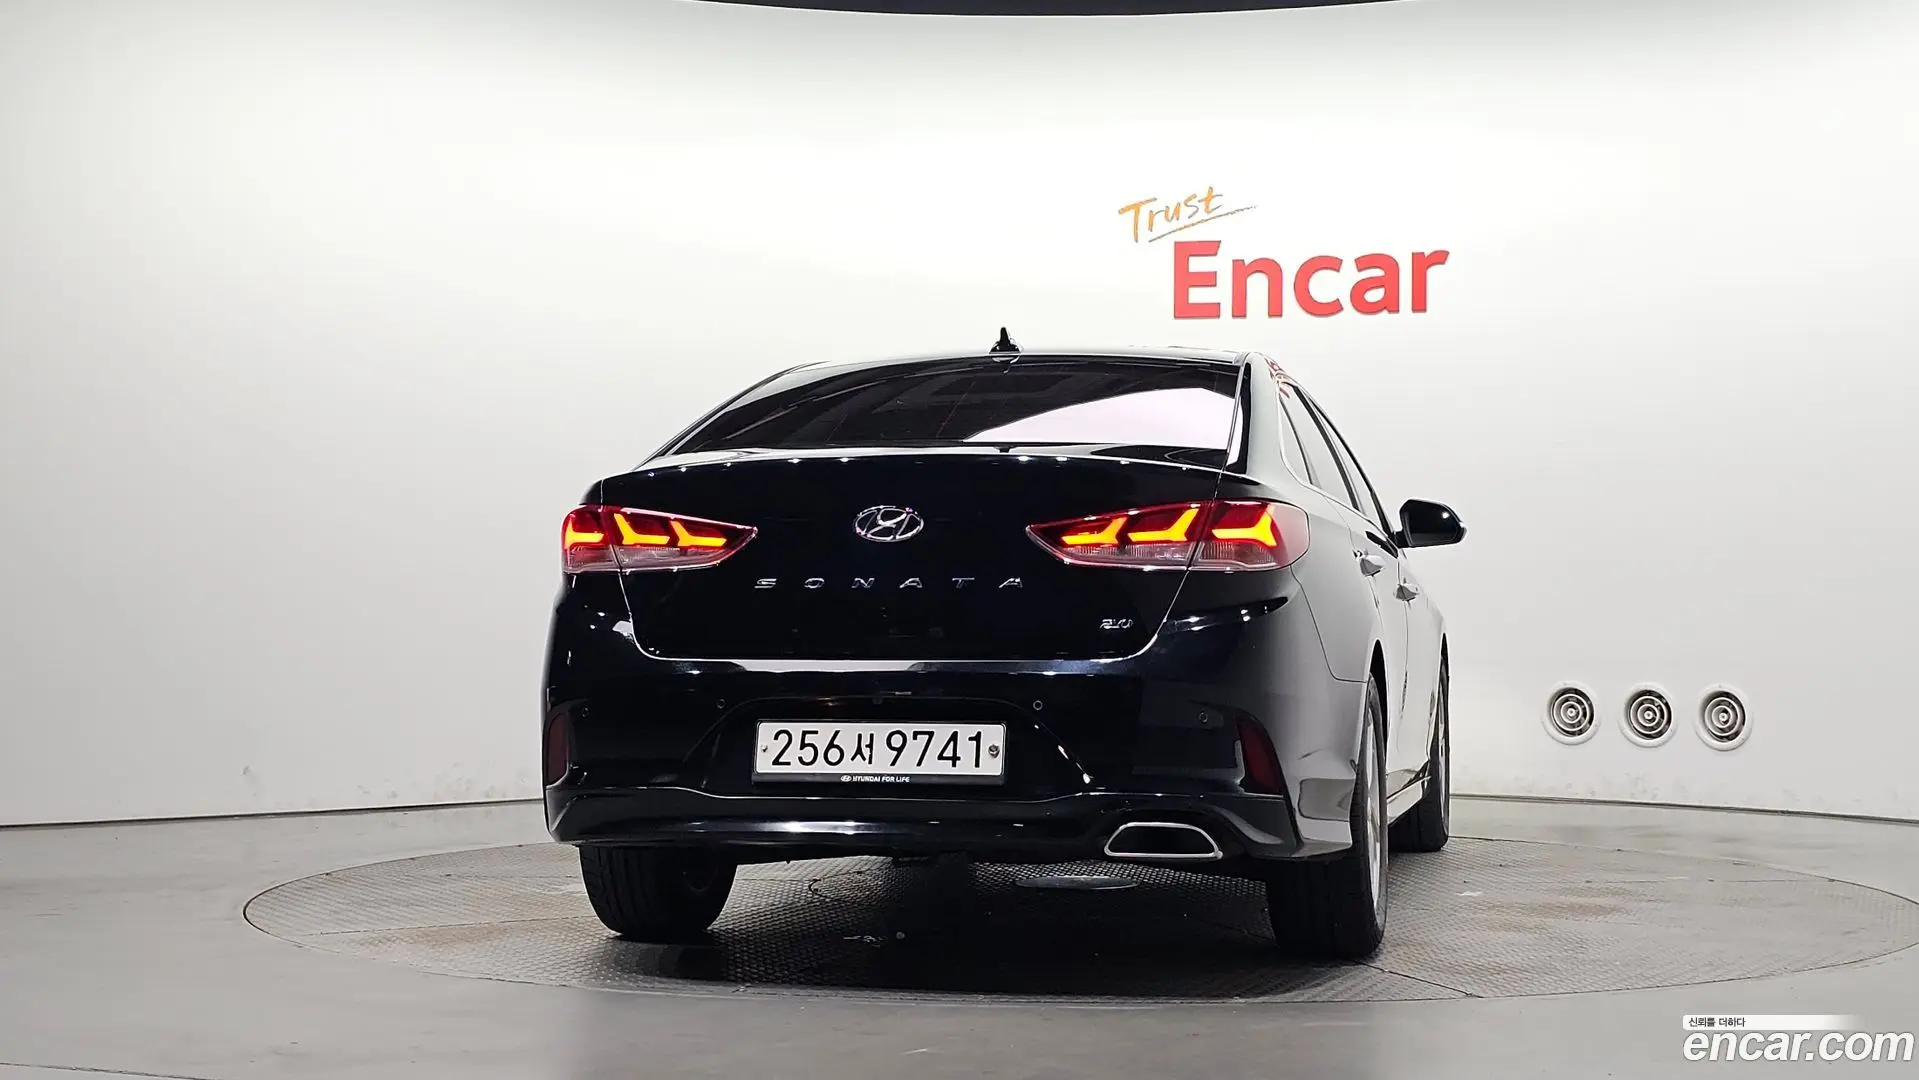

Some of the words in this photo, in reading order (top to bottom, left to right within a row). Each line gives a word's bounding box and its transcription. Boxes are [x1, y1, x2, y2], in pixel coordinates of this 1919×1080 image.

[1118, 186, 1224, 243] Trust
[1173, 240, 1450, 319] Encar
[754, 576, 1024, 590] SONATA
[771, 729, 875, 767] 256서
[885, 729, 983, 768] 9741
[852, 775, 881, 783] HYUNDAI
[881, 775, 896, 783] FOR
